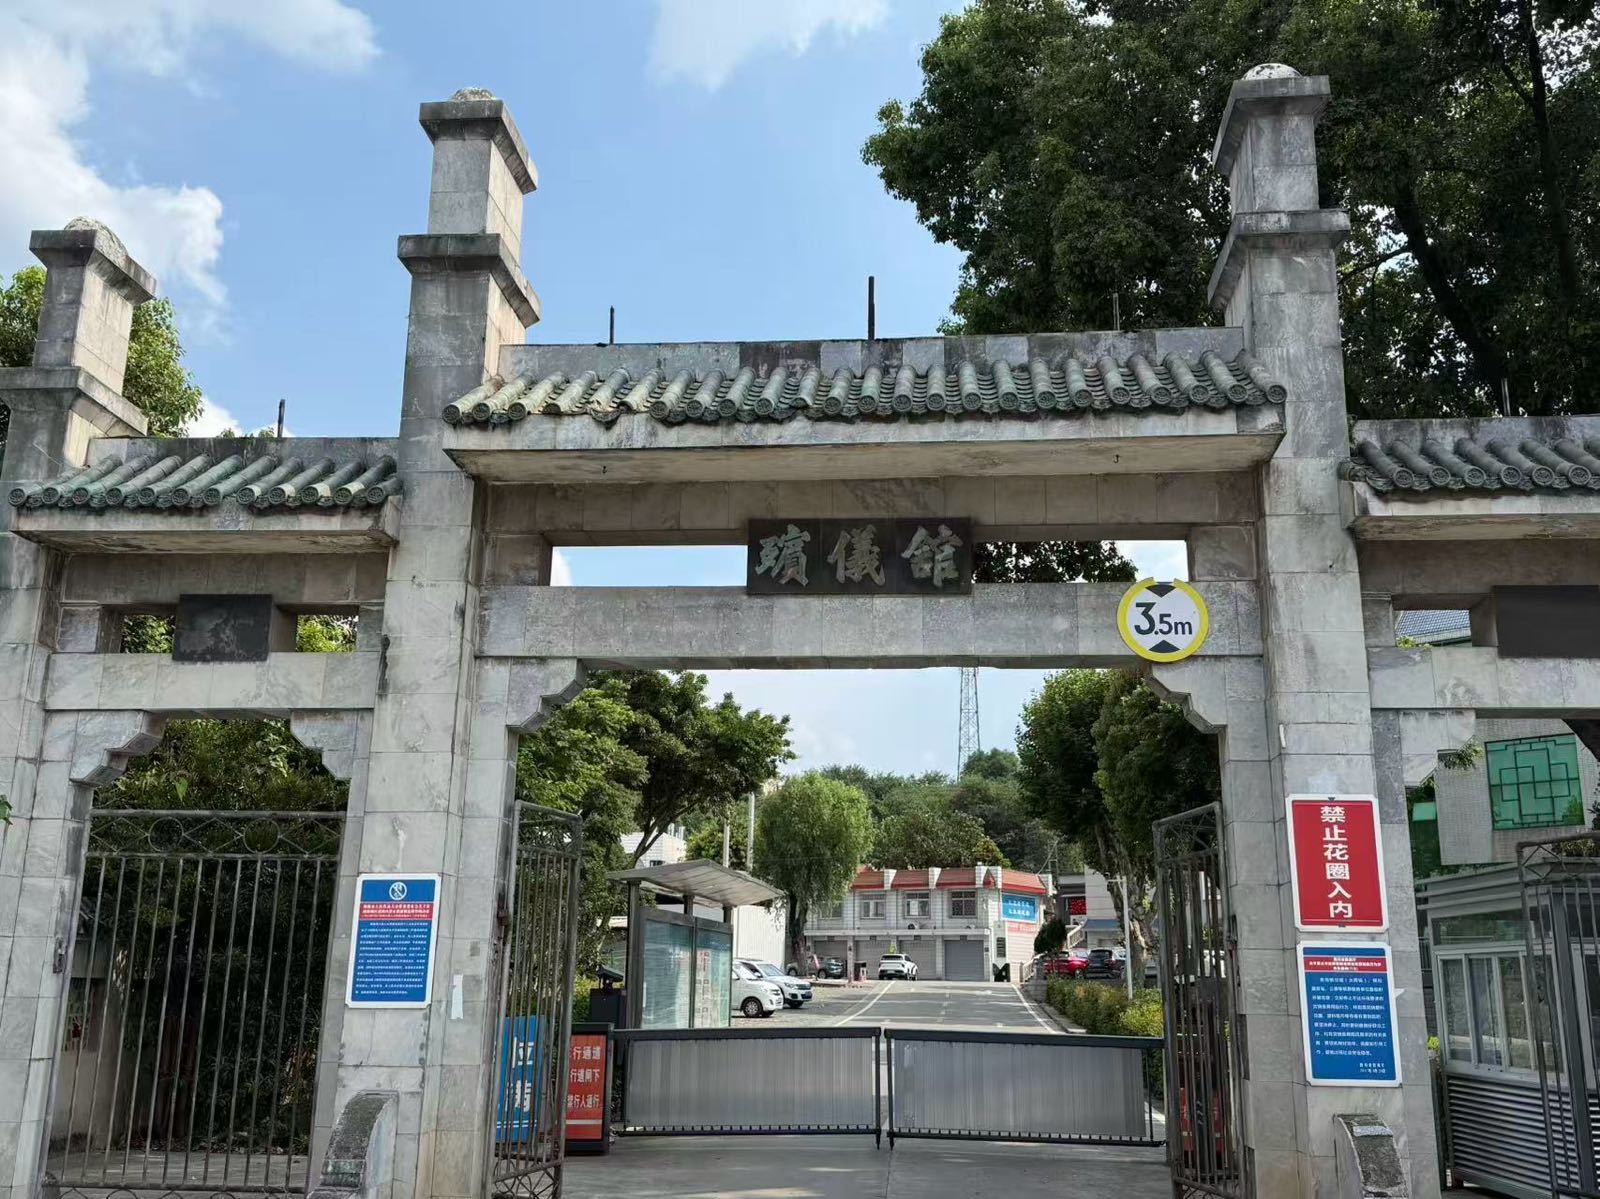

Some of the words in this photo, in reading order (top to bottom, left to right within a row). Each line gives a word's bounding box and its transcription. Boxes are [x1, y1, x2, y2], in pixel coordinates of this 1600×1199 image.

[1134, 602, 1193, 636] 3.5m
[1320, 805, 1353, 919] 禁止花圈入内
[569, 1045, 601, 1060] 行通道
